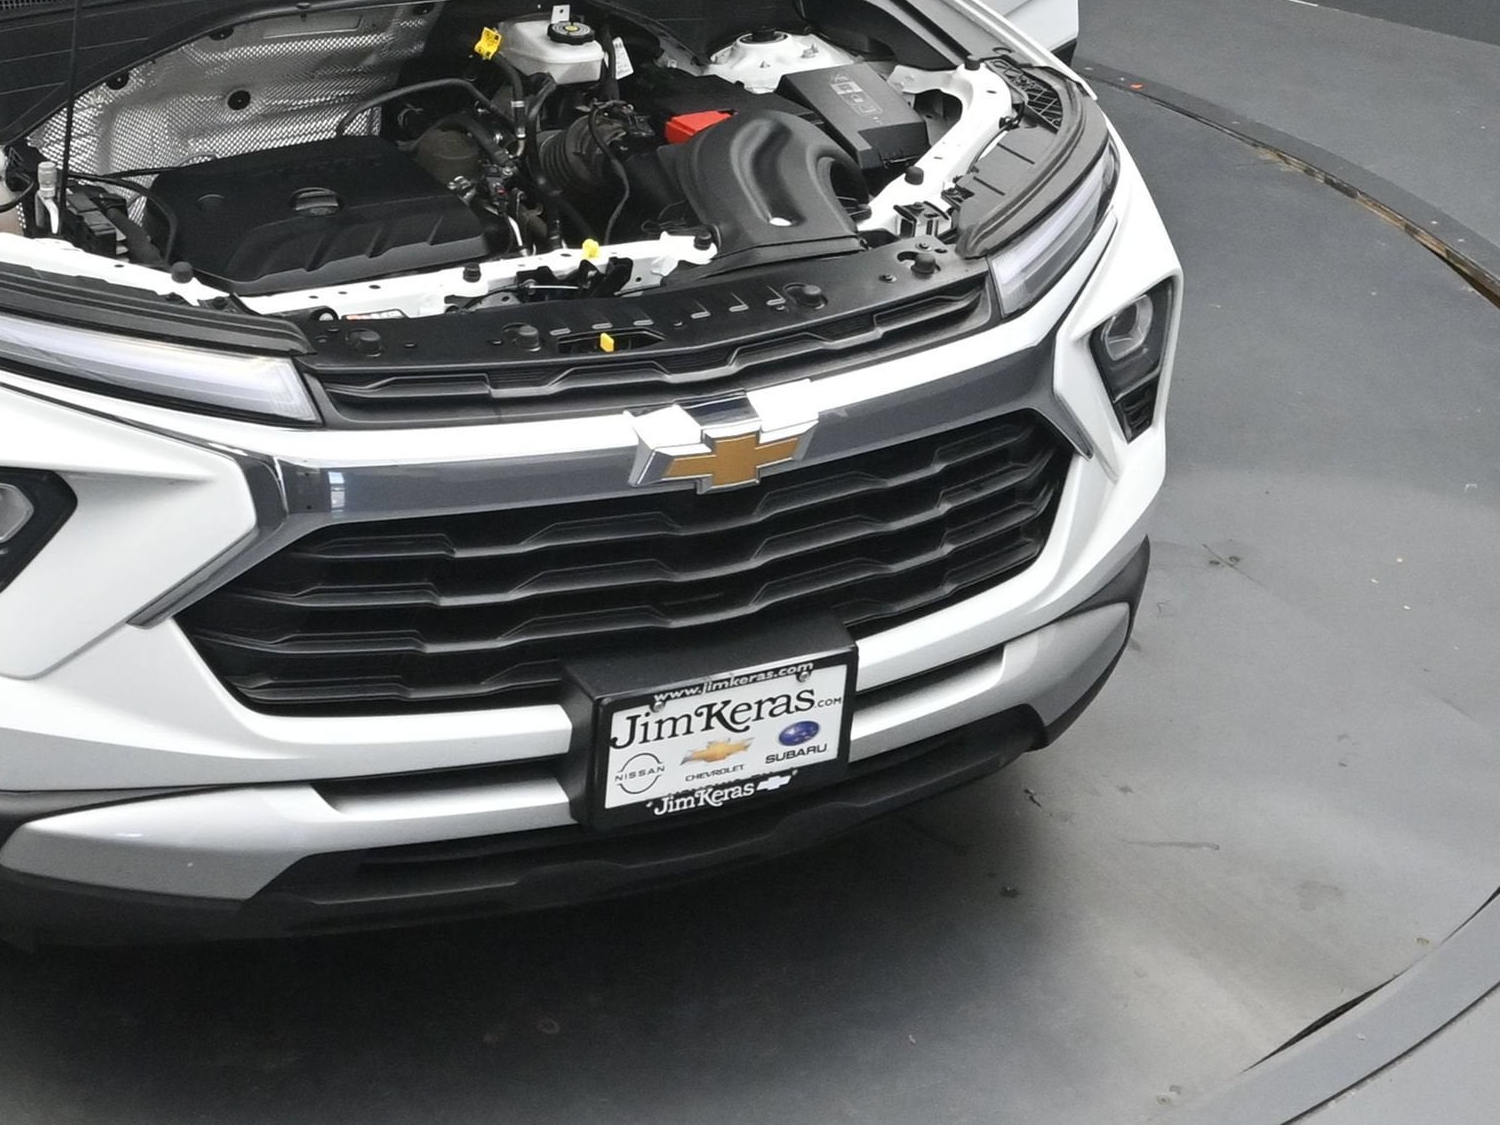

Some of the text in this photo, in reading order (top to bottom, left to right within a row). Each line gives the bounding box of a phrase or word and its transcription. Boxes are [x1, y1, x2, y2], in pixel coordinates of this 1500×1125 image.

[653, 662, 814, 701] www.jimkeras.com
[765, 743, 828, 764] SUBARU
[615, 765, 665, 782] NISSAN
[685, 764, 745, 782] CHEVROLET
[654, 782, 755, 815] JimKeras
